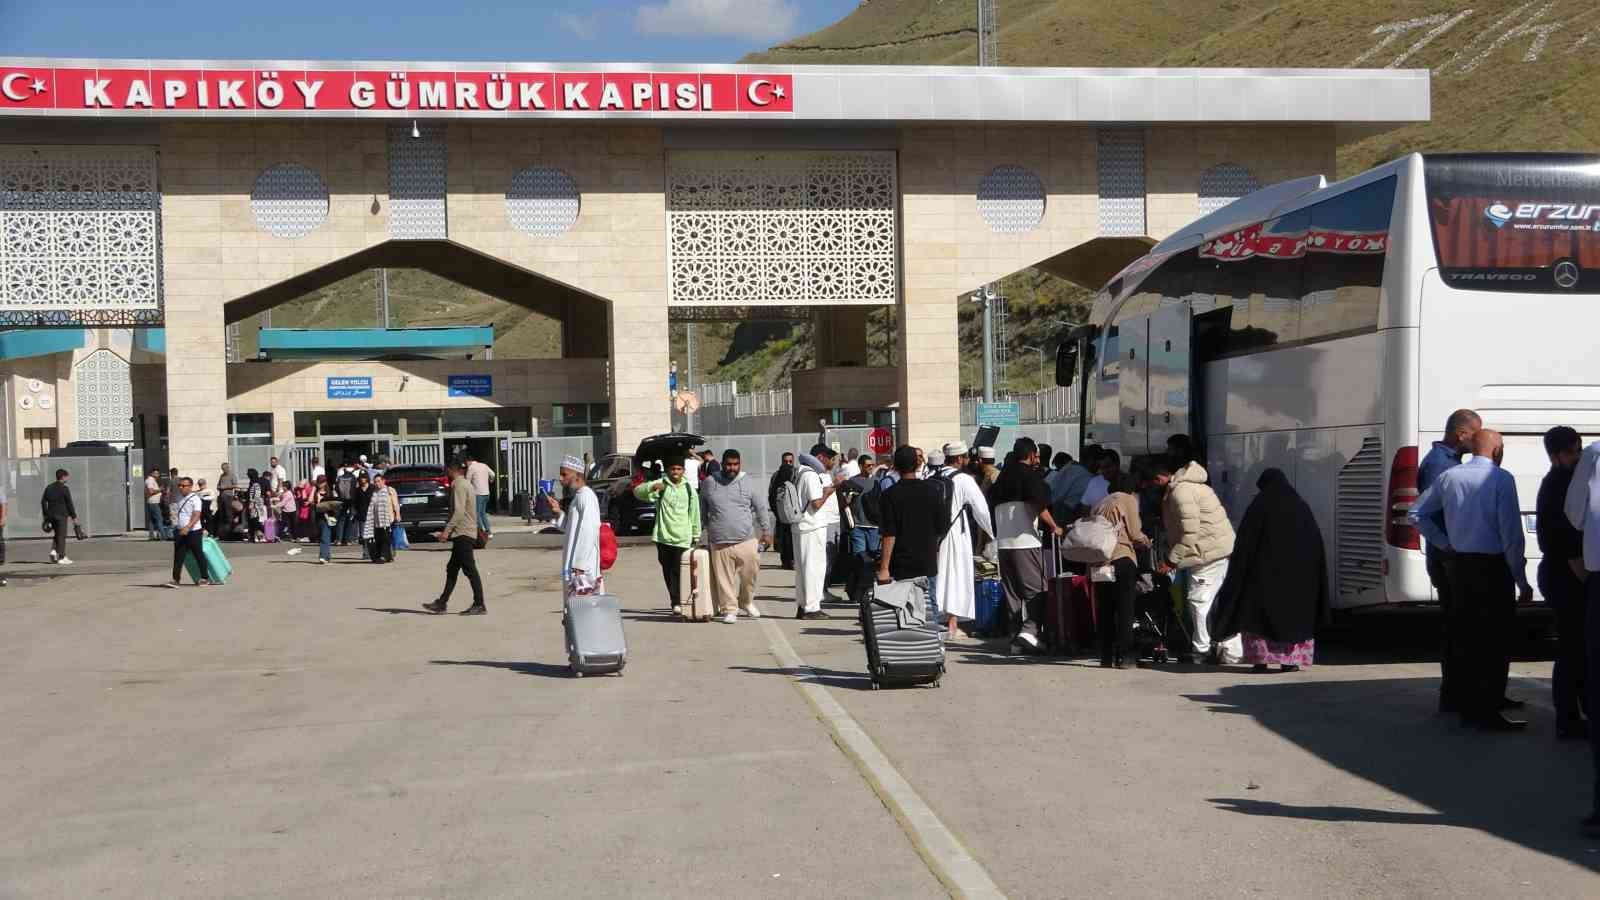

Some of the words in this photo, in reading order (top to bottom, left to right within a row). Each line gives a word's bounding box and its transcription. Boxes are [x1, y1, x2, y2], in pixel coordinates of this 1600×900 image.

[84, 71, 324, 109] KAPIKÖY
[349, 72, 545, 109] GÜMRÜK
[563, 81, 713, 110] KAPISI
[870, 436, 891, 448] DUR
